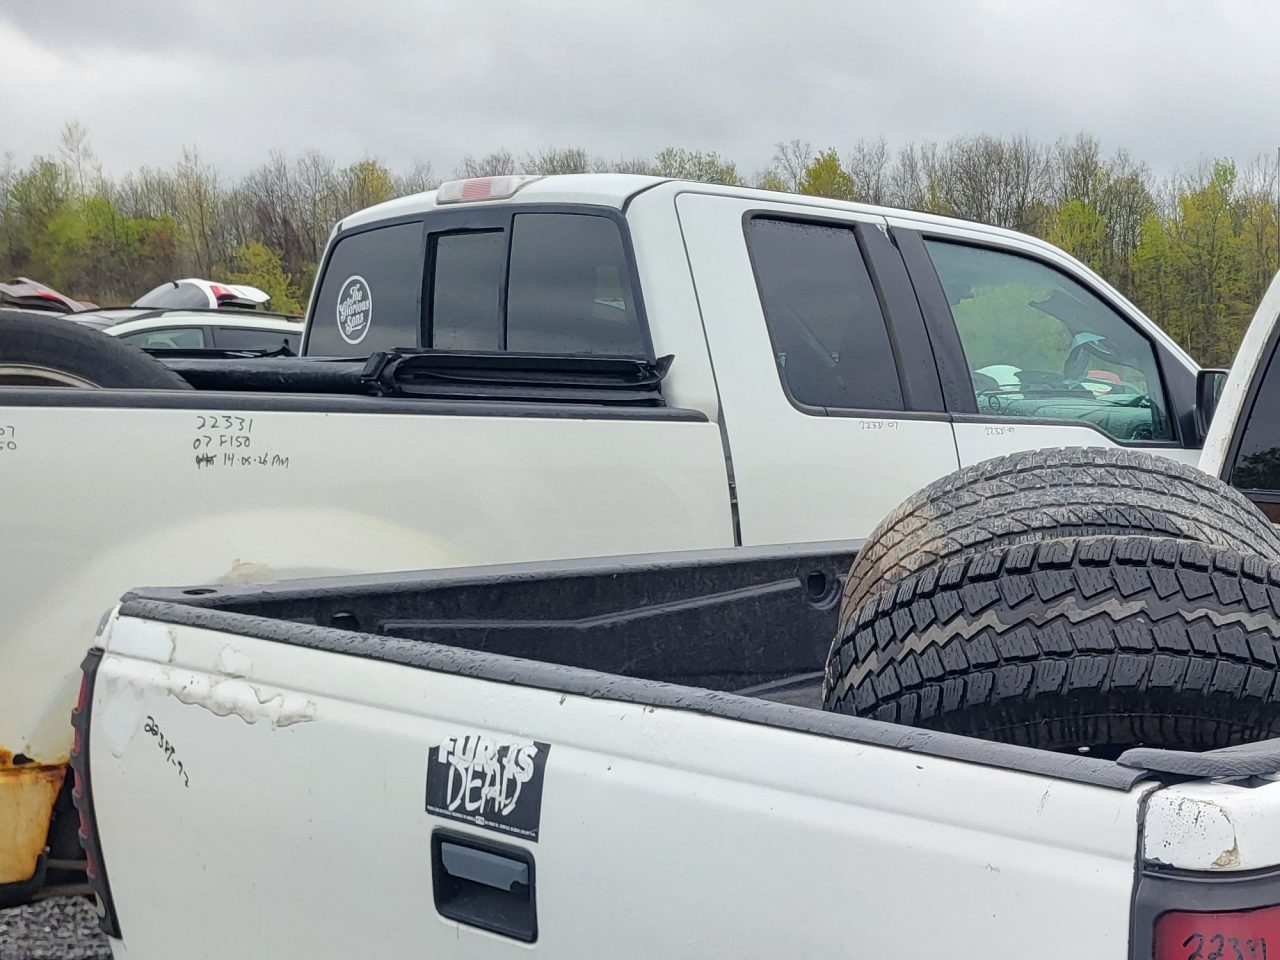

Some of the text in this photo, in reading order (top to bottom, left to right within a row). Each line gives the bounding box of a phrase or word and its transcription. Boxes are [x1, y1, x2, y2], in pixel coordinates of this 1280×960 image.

[349, 283, 363, 302] The
[339, 297, 370, 322] Glorious
[344, 312, 365, 335] Sons
[196, 415, 253, 433] 22331
[193, 434, 251, 450] 07 F150
